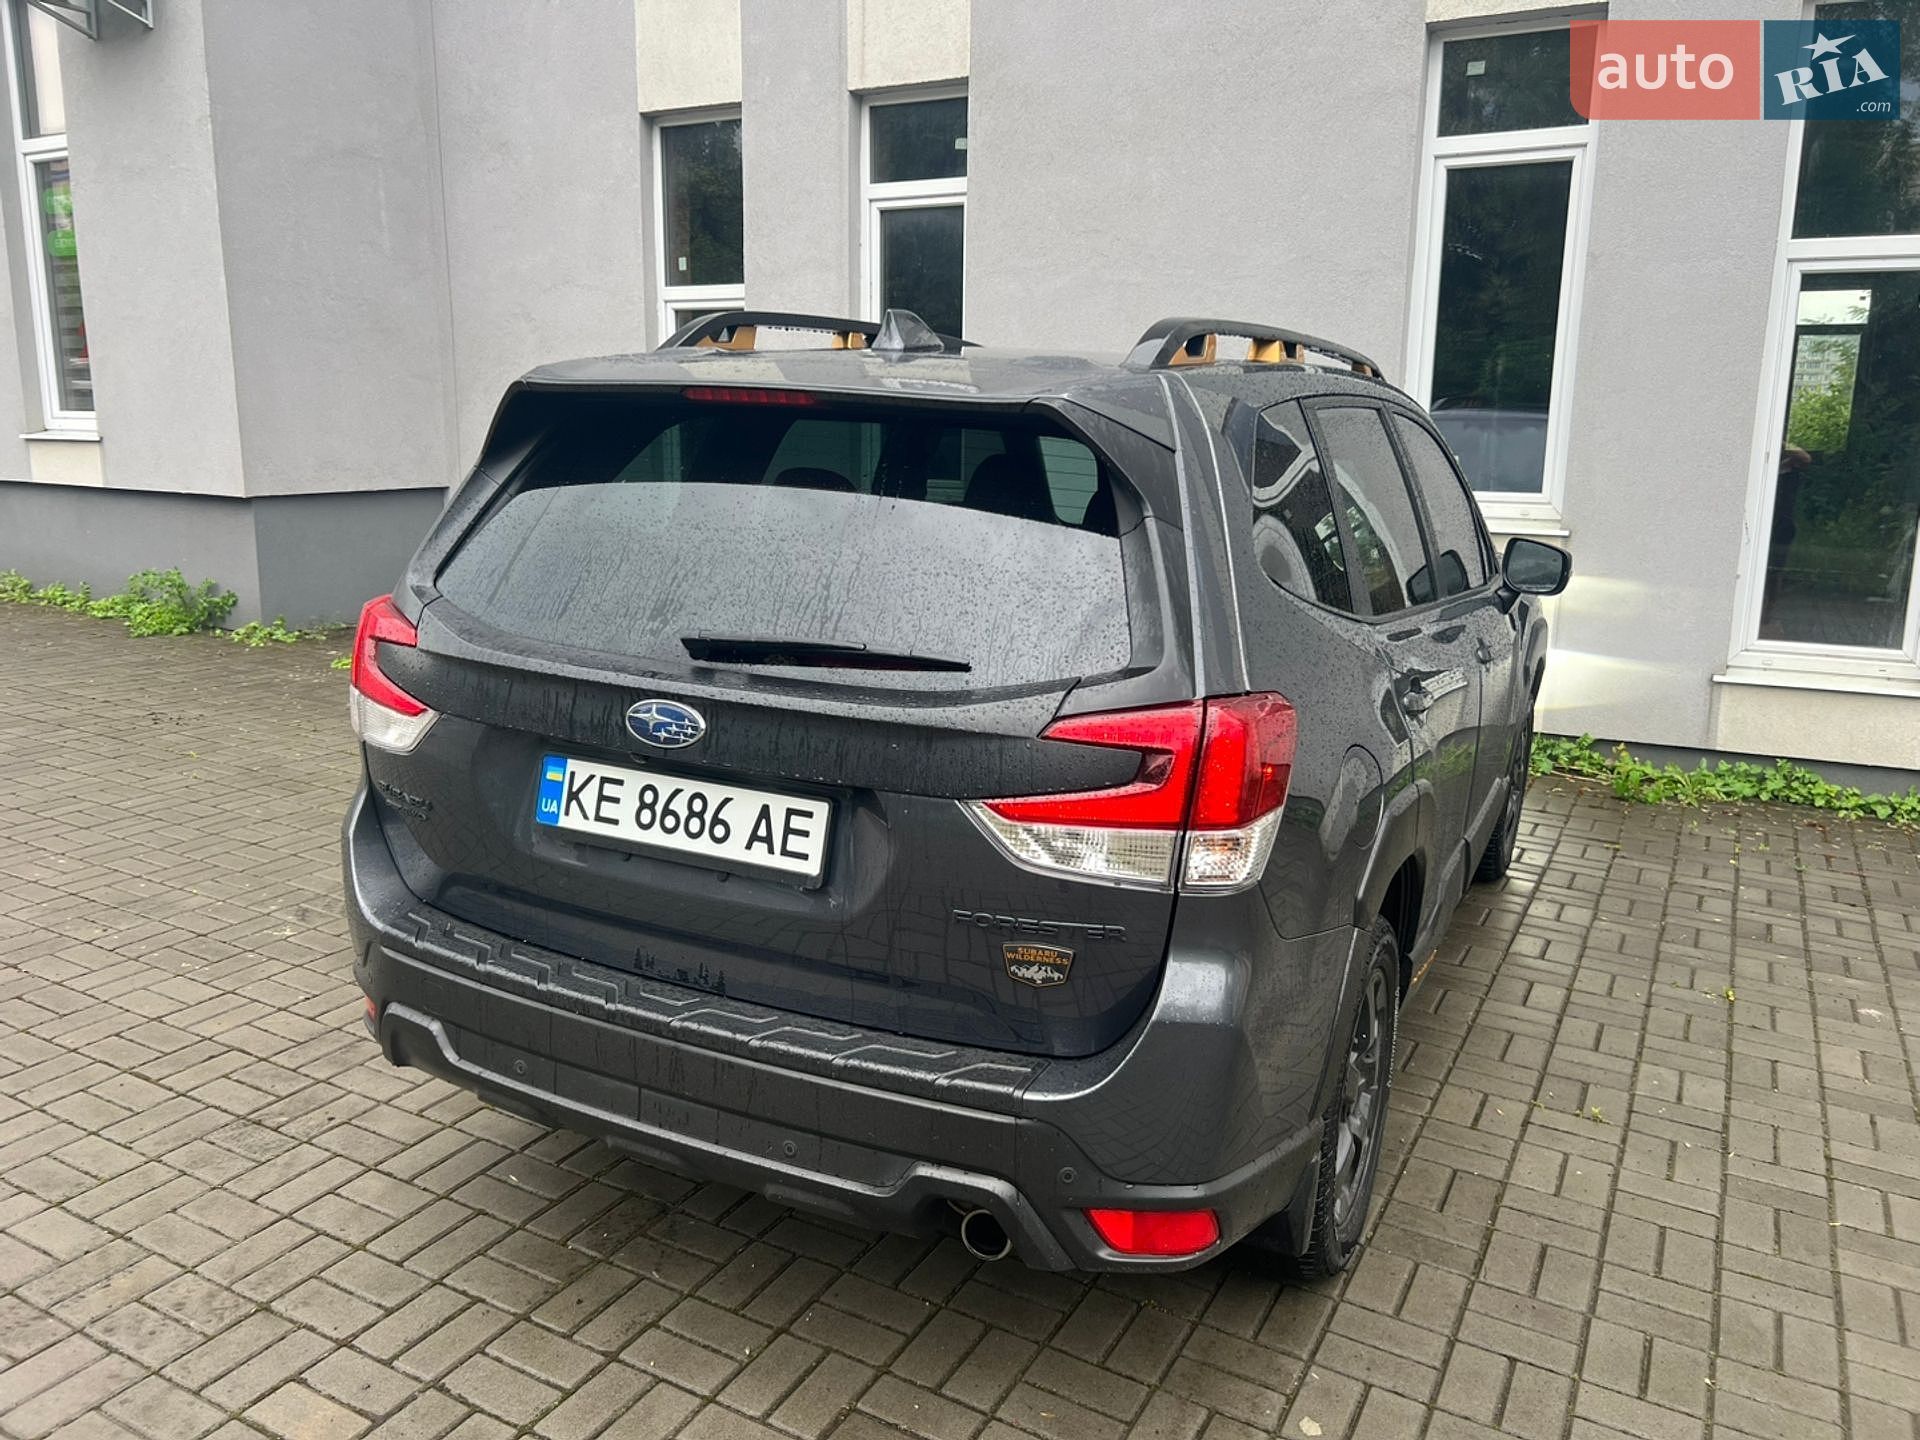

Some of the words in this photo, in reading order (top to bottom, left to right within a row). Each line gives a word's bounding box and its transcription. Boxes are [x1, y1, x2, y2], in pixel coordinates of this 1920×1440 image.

[541, 797, 558, 814] UA
[563, 769, 625, 827] KE
[634, 783, 735, 845] 8686
[744, 803, 815, 861] AE
[952, 908, 1127, 943] FORESTER
[1006, 951, 1070, 965] WILDERNESS
[1017, 946, 1058, 958] SUBARU
